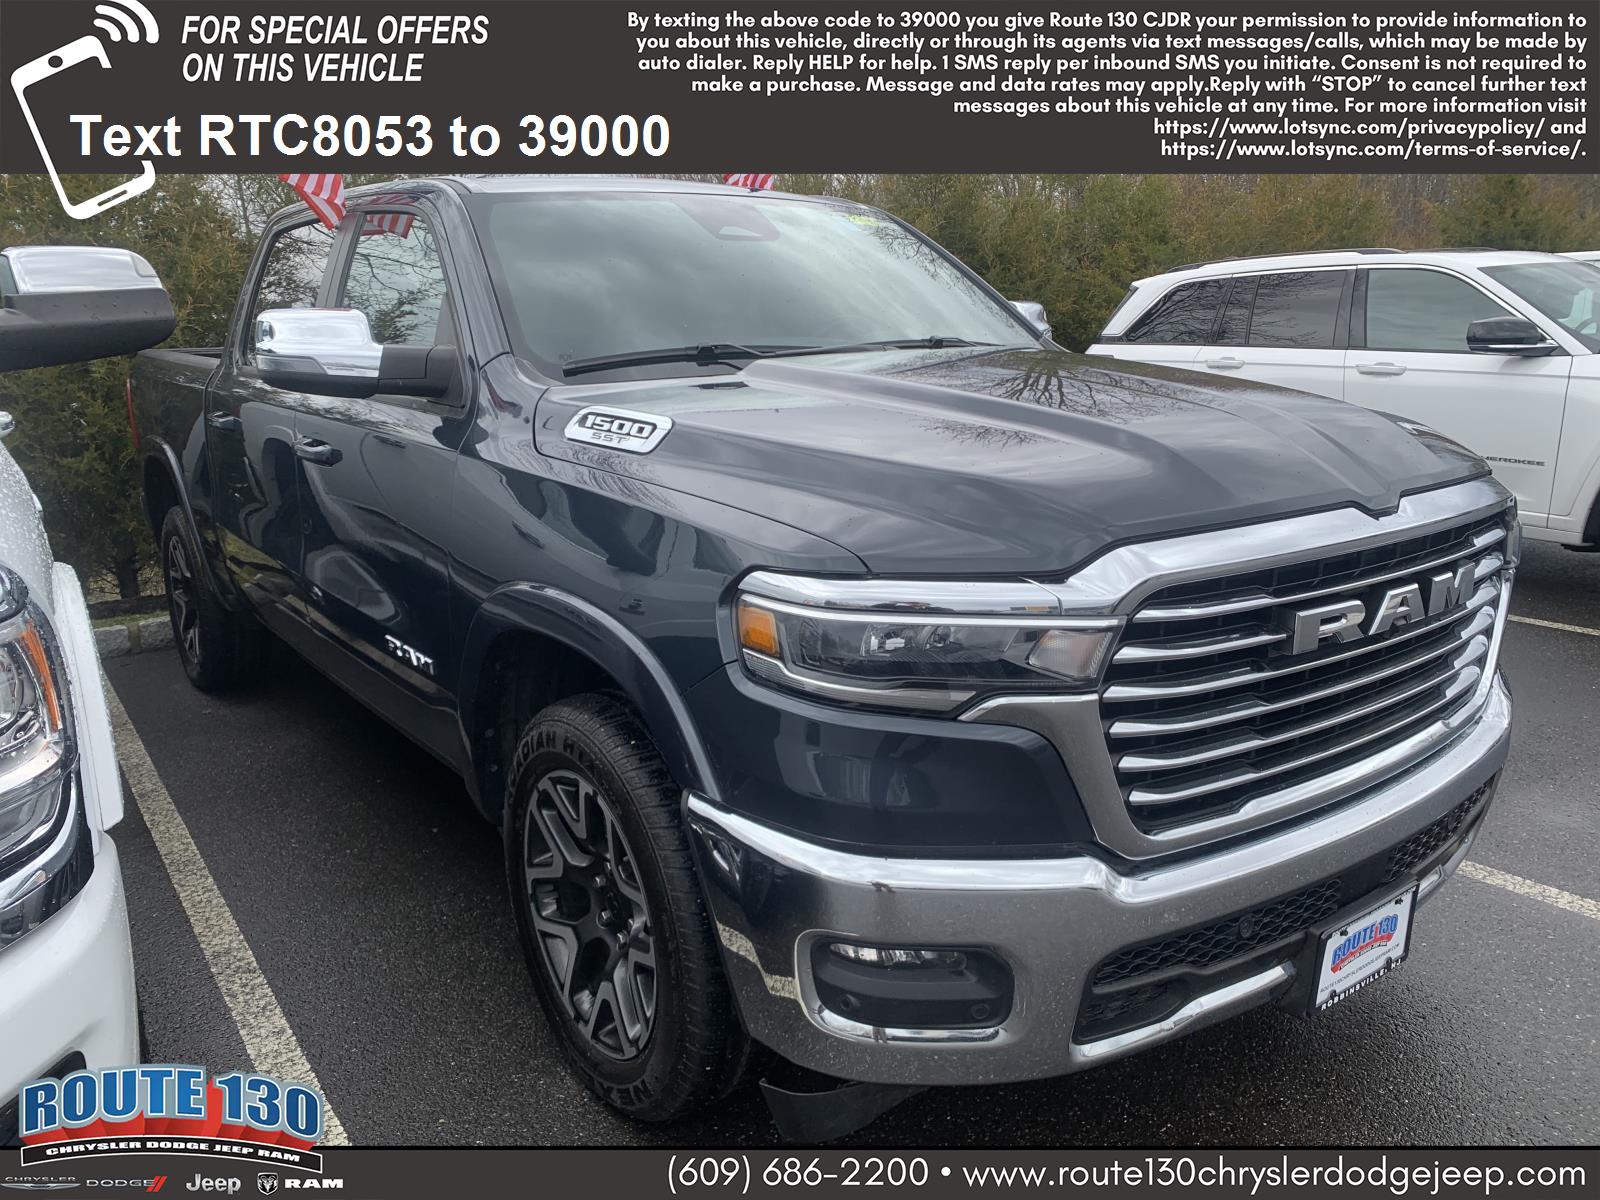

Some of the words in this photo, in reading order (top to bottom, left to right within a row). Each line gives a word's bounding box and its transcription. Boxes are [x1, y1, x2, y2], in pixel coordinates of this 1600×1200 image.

[584, 414, 653, 438] 1500
[591, 432, 630, 444] SST
[1480, 456, 1545, 467] HEROKEE
[1292, 562, 1476, 656] RAM
[1331, 921, 1378, 968] ROUTE
[1377, 914, 1399, 937] 130
